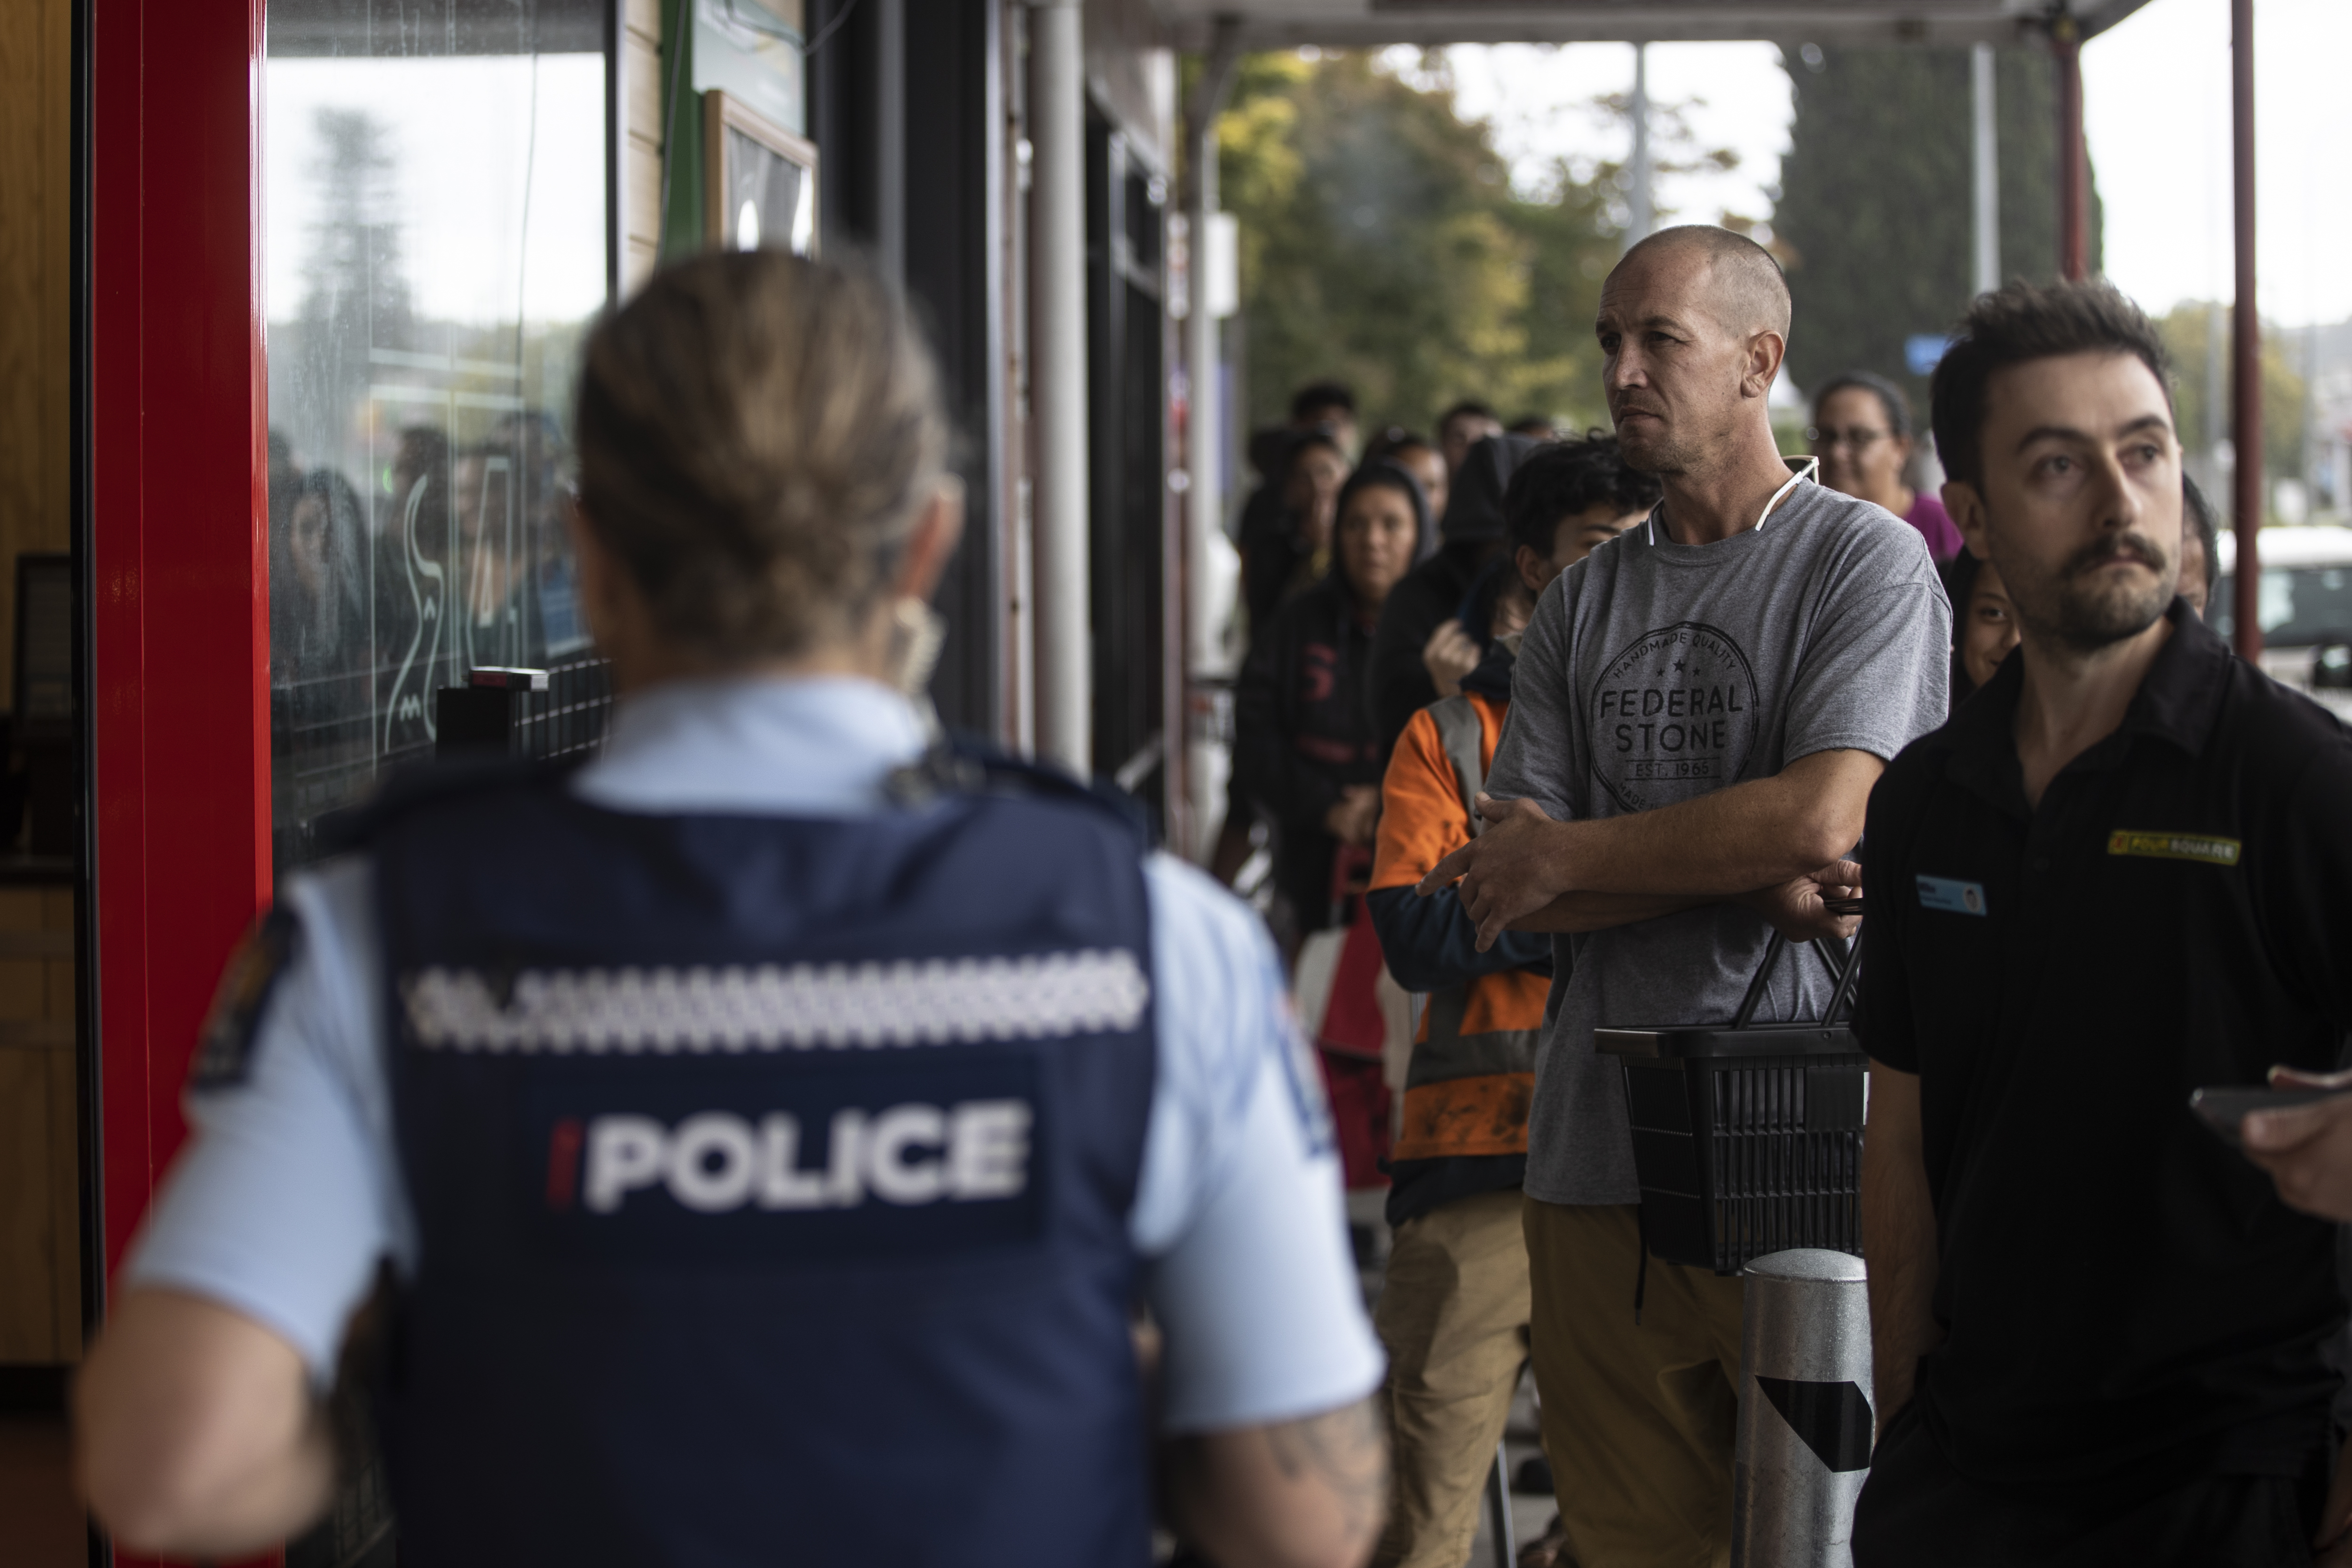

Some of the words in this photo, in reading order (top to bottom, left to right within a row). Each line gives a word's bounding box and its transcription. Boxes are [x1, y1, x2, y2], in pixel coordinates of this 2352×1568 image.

[1613, 632, 1687, 678] HANDMADE
[1692, 633, 1736, 670] QUALITY
[1600, 684, 1743, 718] FEDERAL
[1615, 720, 1725, 752] STONE
[1636, 763, 1668, 776] EST.
[1676, 761, 1709, 776] 1965
[1618, 782, 1646, 809] MADE
[582, 1096, 1032, 1214] POLICE
